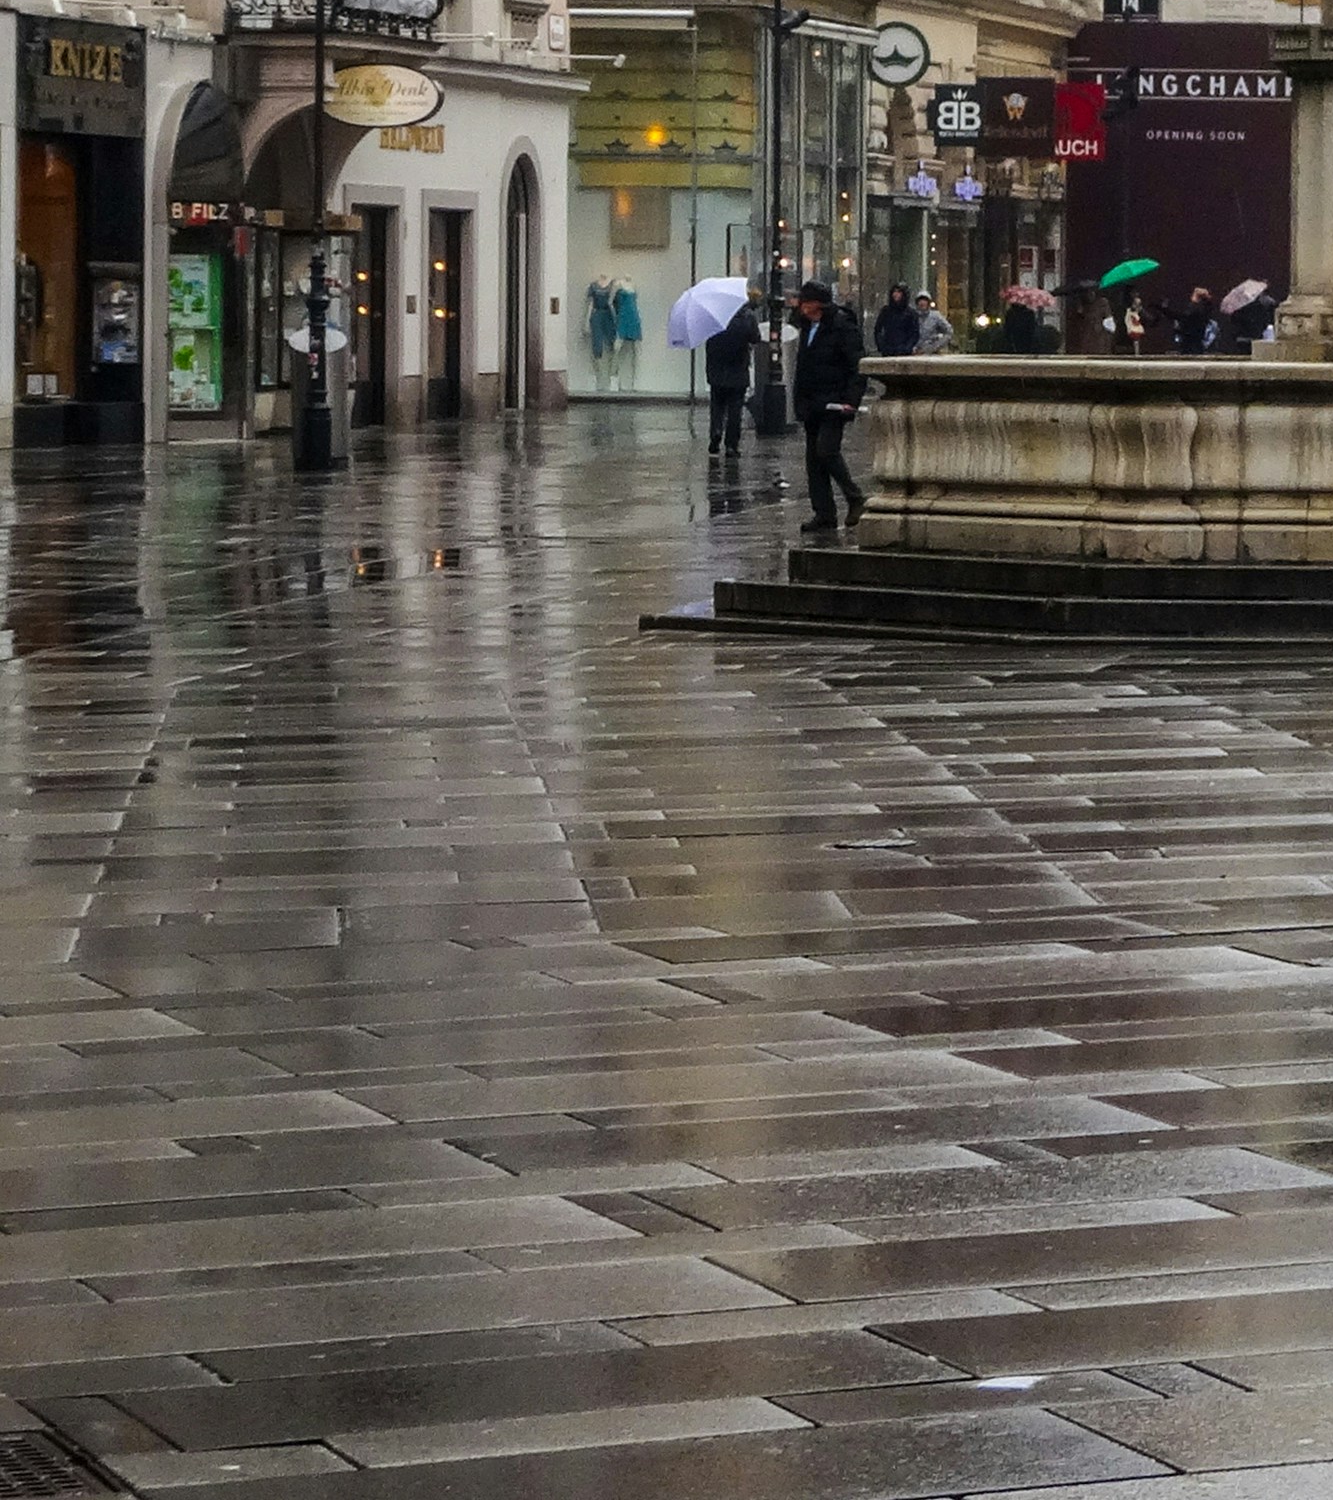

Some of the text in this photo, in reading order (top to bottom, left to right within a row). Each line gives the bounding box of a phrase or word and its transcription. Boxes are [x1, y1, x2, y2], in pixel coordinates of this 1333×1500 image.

[51, 39, 123, 83] KNIZE
[1146, 130, 1246, 142] OPENING SOON
[1055, 139, 1098, 156] UCH
[191, 202, 230, 220] FILZ
